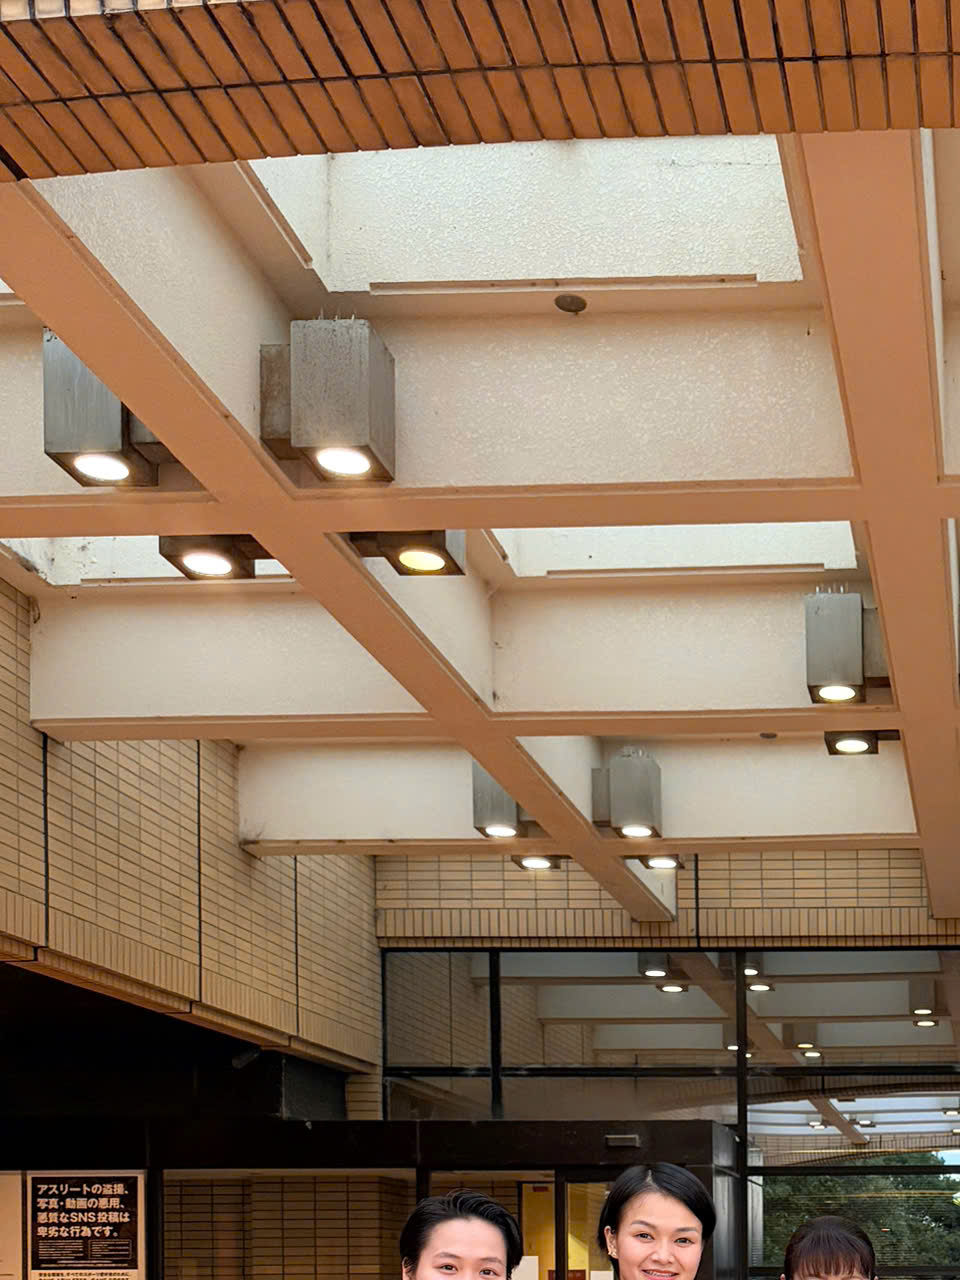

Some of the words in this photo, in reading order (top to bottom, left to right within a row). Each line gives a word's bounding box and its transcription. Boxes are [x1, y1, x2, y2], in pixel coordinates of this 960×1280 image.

[37, 1226, 118, 1237] 卑劣な行為です。
